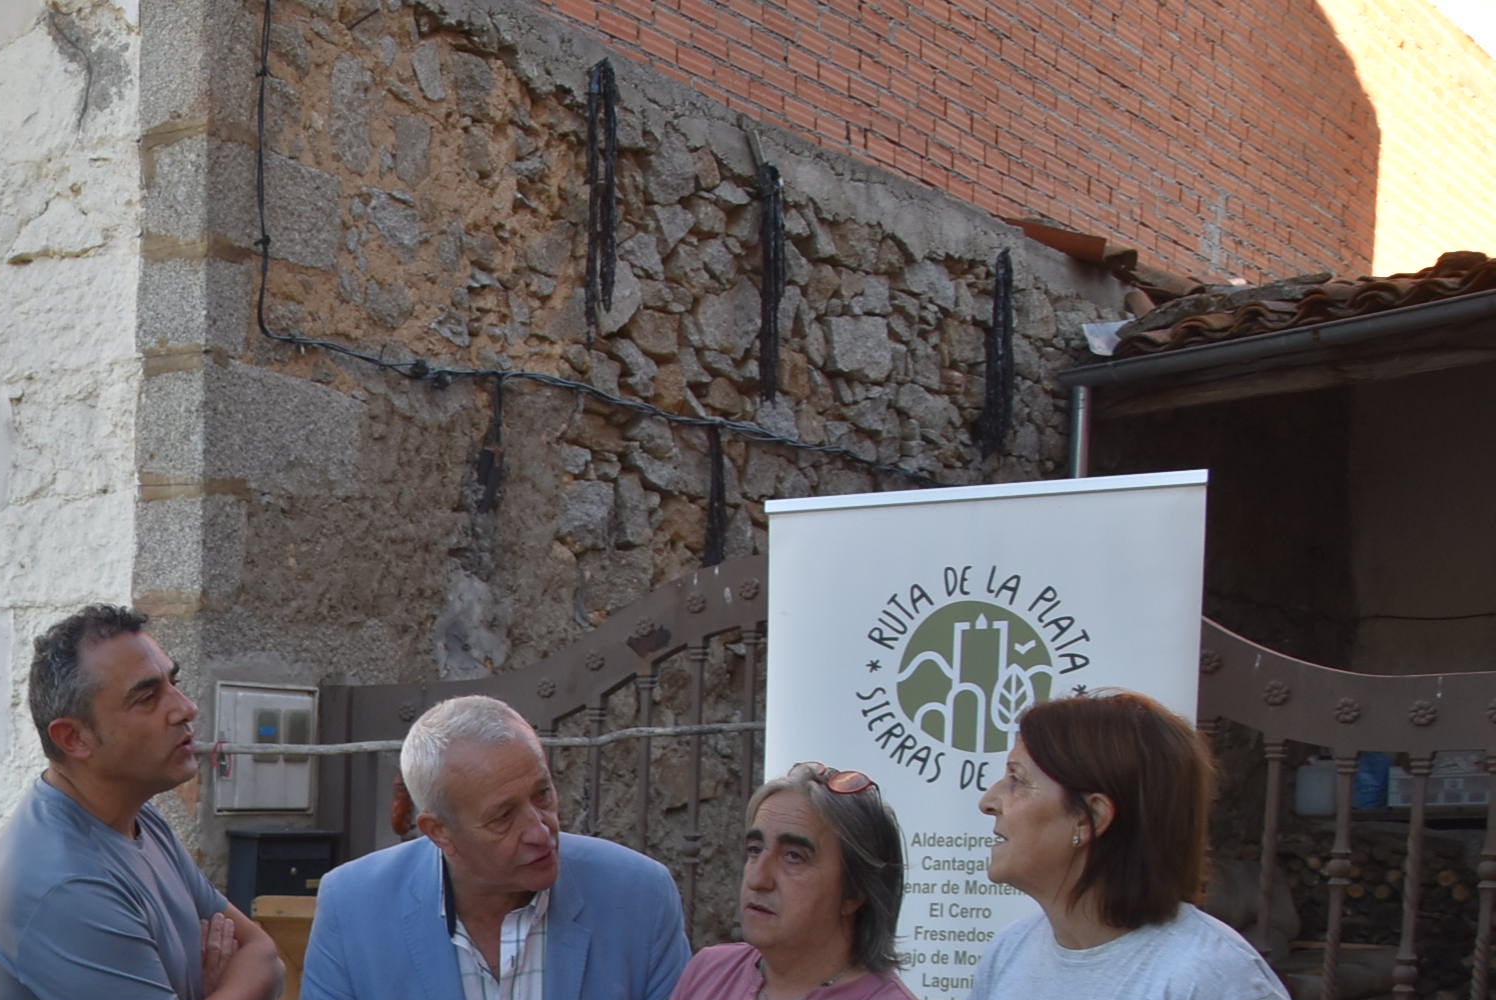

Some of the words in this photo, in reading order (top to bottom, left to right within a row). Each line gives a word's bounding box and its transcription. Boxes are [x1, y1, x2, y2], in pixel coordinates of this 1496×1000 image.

[868, 583, 934, 650] RUTA
[943, 565, 972, 597] DE
[987, 565, 1022, 606] LA
[1027, 586, 1090, 675] PLATA
[856, 686, 946, 784] SIERRAS
[959, 759, 990, 792] DE
[911, 832, 1004, 851] Aldeacipres
[921, 855, 989, 875] Cantagal
[903, 881, 937, 894] enar
[941, 880, 960, 895] de
[929, 902, 944, 918] El
[948, 902, 992, 919] Cerro
[901, 948, 926, 968] ajo
[930, 949, 949, 965] de
[922, 972, 975, 992] Laguni
